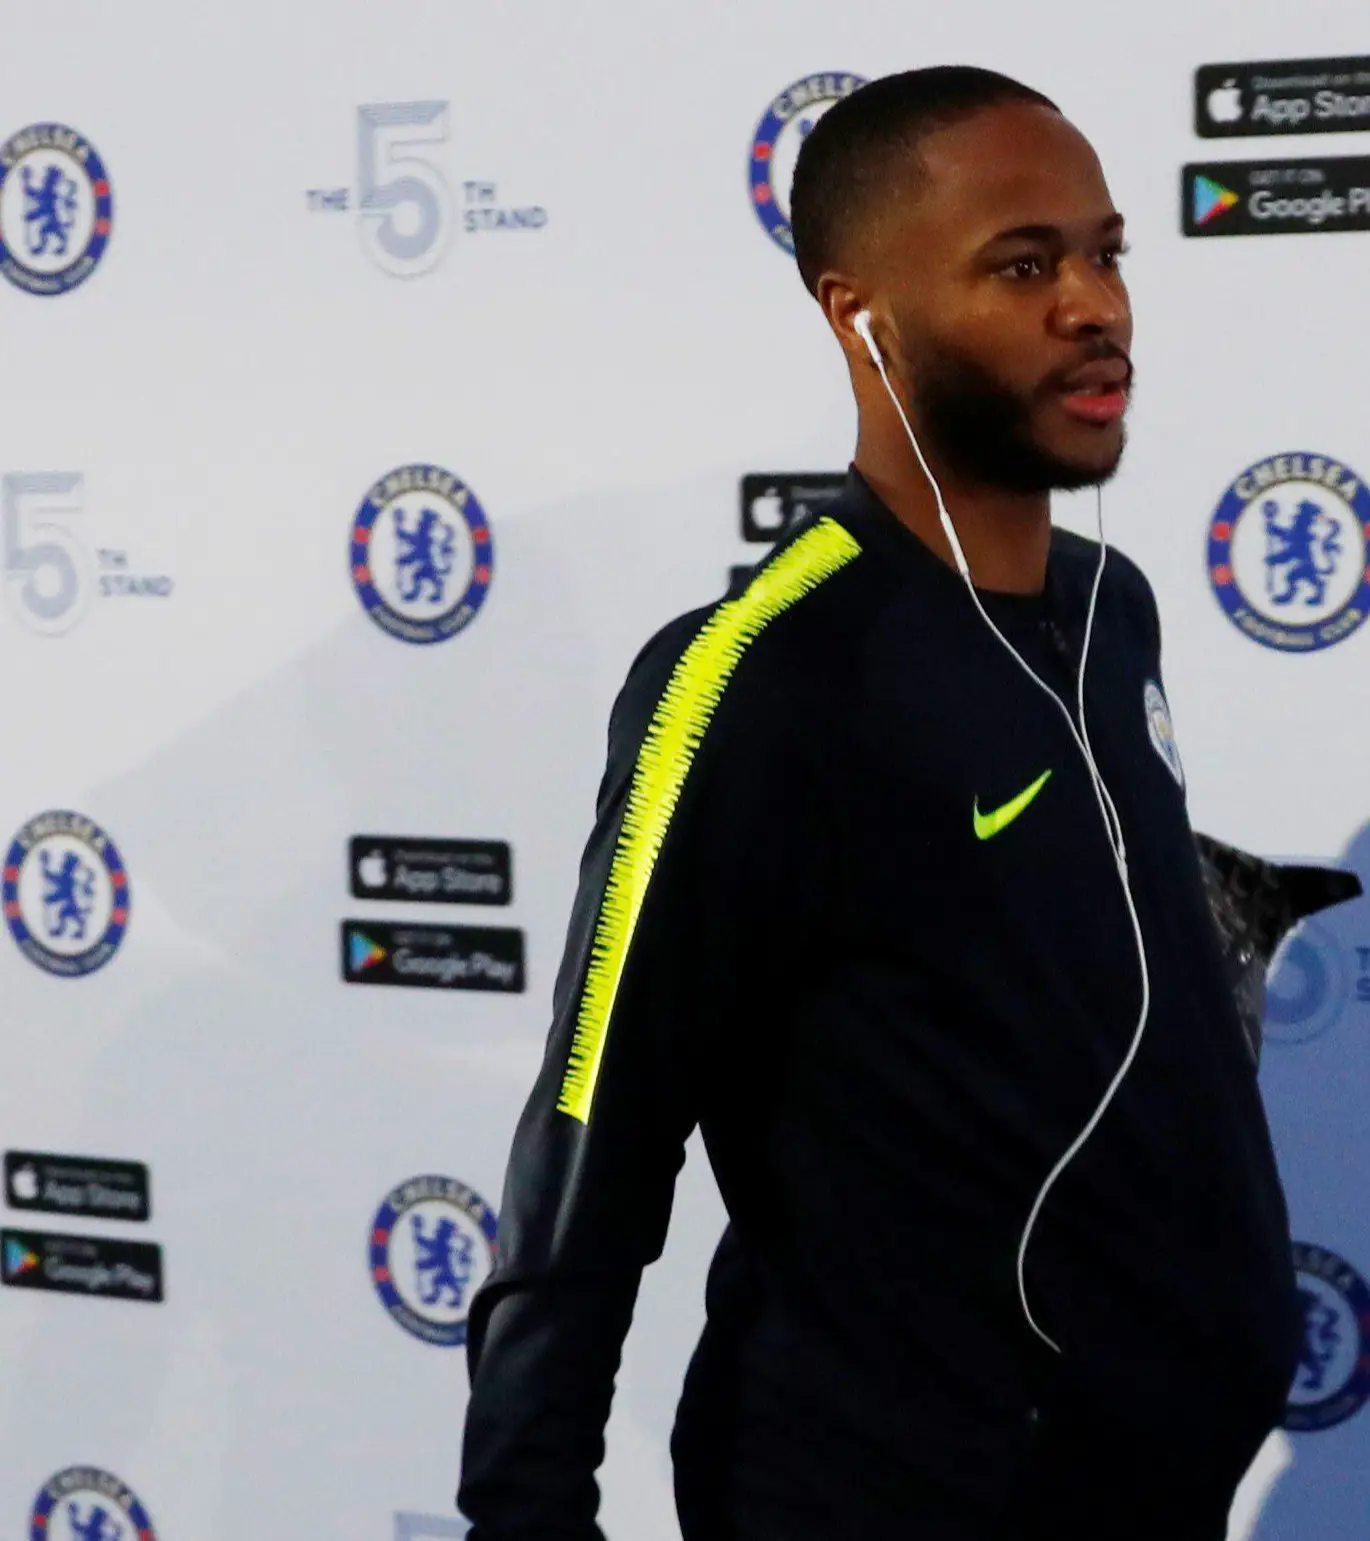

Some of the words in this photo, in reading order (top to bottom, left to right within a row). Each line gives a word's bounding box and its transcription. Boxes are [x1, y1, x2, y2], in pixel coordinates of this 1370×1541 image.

[771, 75, 870, 120] CHELS
[1250, 94, 1311, 125] App
[305, 186, 349, 213] THE
[356, 99, 455, 282] 5
[462, 179, 495, 205] TH
[1248, 188, 1346, 224] Google
[462, 204, 549, 233] STAND
[1234, 456, 1358, 501] CHELSEA
[2, 470, 86, 640] 5
[98, 573, 177, 600] STAND
[392, 864, 439, 894] App
[440, 865, 503, 894] Store
[391, 946, 468, 984] Google
[468, 951, 517, 988] Play
